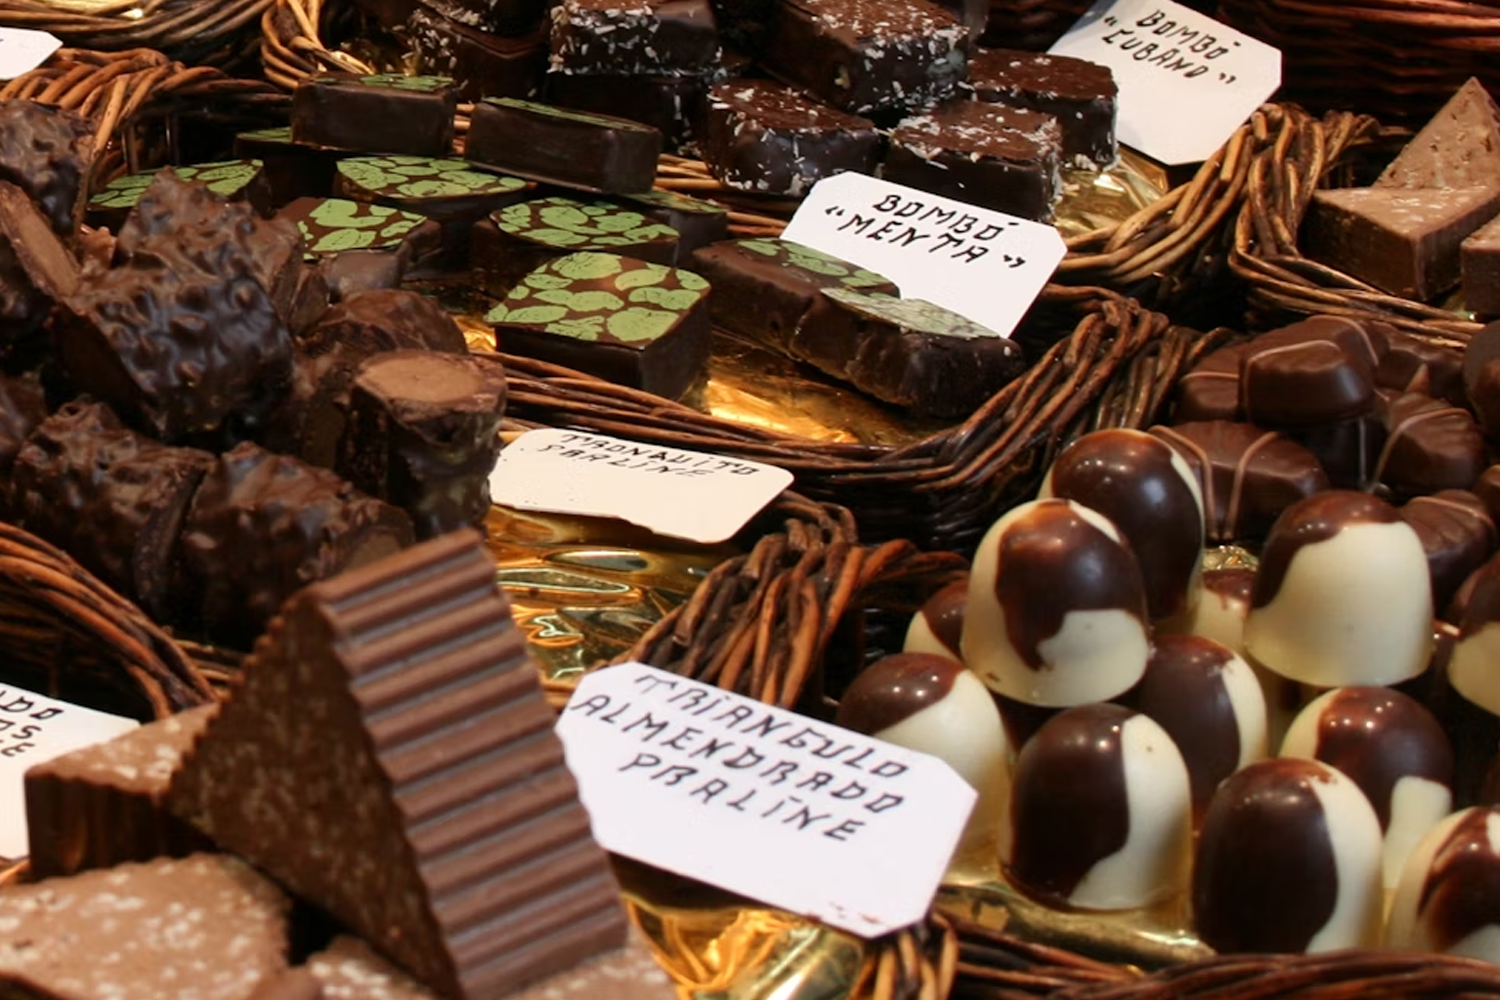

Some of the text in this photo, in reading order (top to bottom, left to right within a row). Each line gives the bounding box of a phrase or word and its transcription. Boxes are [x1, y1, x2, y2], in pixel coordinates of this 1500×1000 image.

[570, 694, 907, 815] ALMENDRADO
[634, 672, 910, 779] TRIANGULO
[618, 752, 866, 843] PRALINE
